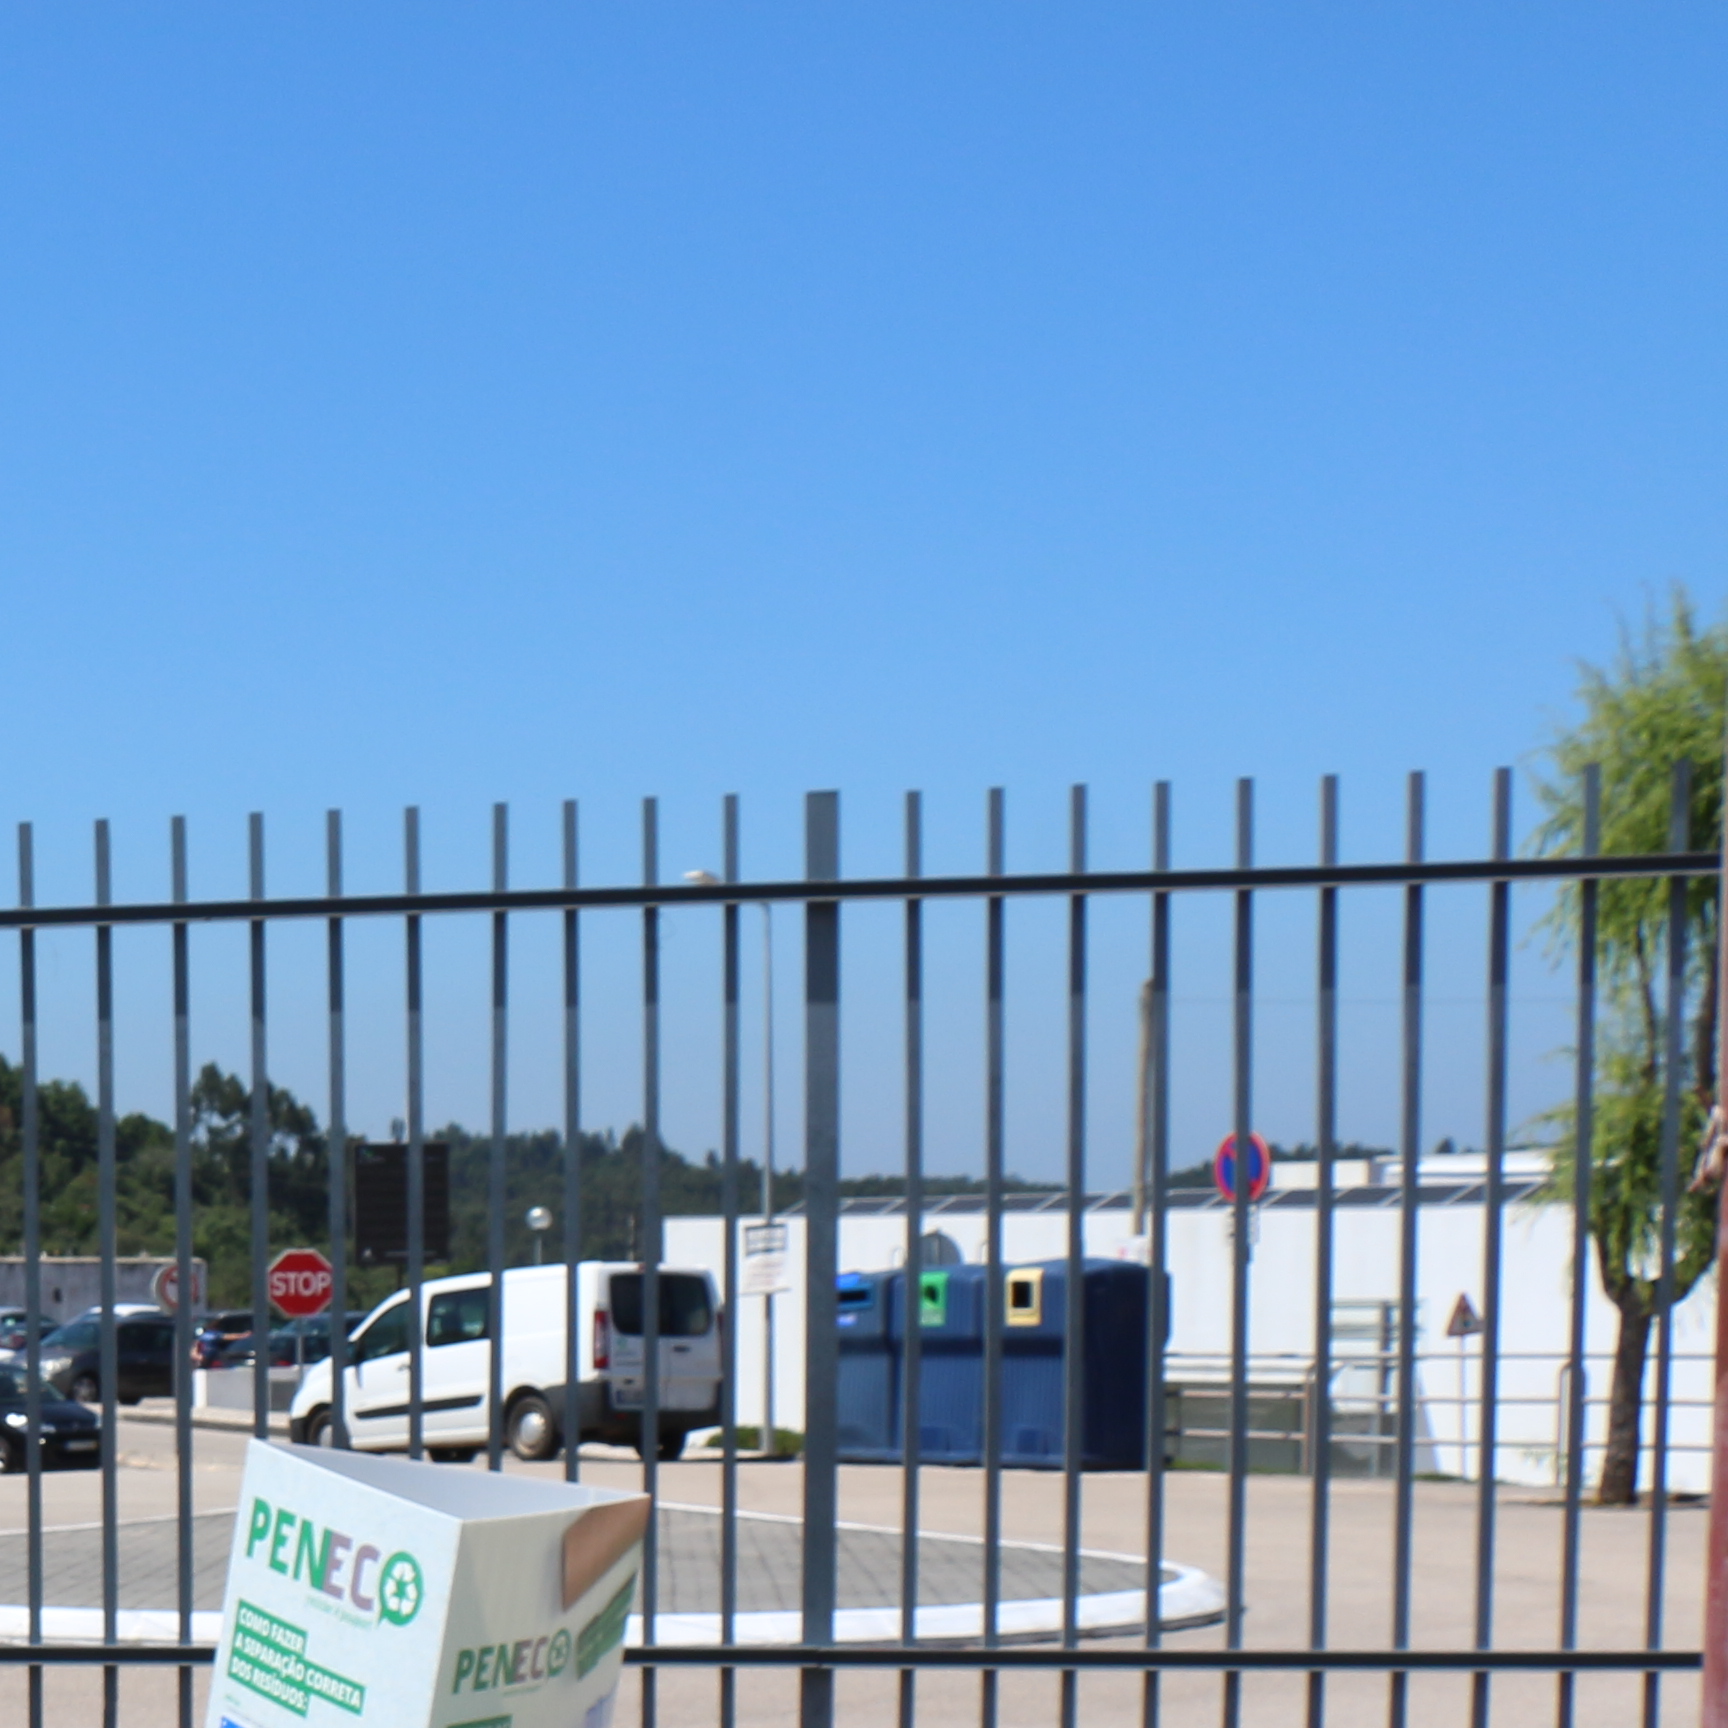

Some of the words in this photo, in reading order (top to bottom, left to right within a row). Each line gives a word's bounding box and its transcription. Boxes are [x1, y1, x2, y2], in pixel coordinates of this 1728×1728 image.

[272, 1270, 332, 1297] STOP
[246, 1497, 424, 1626] PENECO
[238, 1607, 270, 1638] COMO
[270, 1622, 306, 1654] FAZER
[231, 1656, 253, 1682] DOS
[252, 1667, 307, 1709] RESÍDUOS:
[235, 1632, 244, 1649] A
[244, 1635, 306, 1683] SEPARAÇÃO
[305, 1668, 362, 1709] CORRETA
[451, 1627, 571, 1695] PENECO
